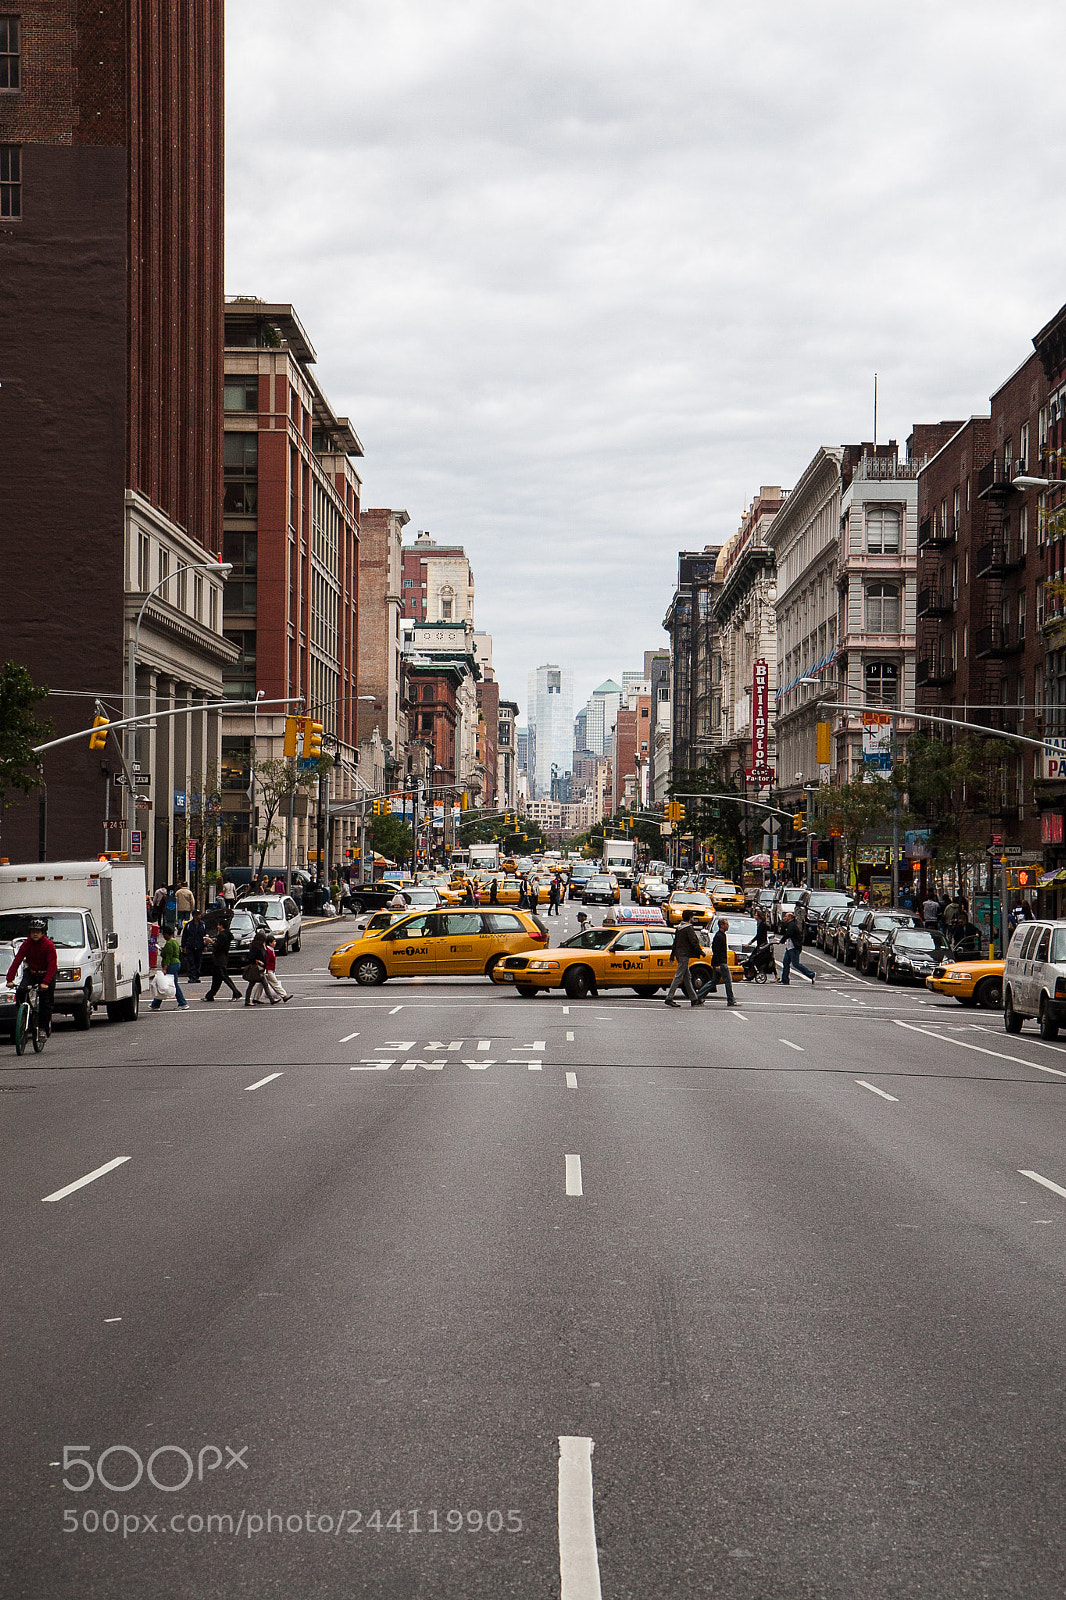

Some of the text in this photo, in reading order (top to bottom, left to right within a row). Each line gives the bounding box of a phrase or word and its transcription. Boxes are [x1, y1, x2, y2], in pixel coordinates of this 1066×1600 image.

[755, 665, 767, 768] Burlington
[102, 821, 126, 829] W 24 ST
[406, 946, 428, 956] TAXI
[622, 960, 643, 970] TAXI
[374, 1040, 547, 1051] FIRE
[349, 1059, 543, 1071] LANE
